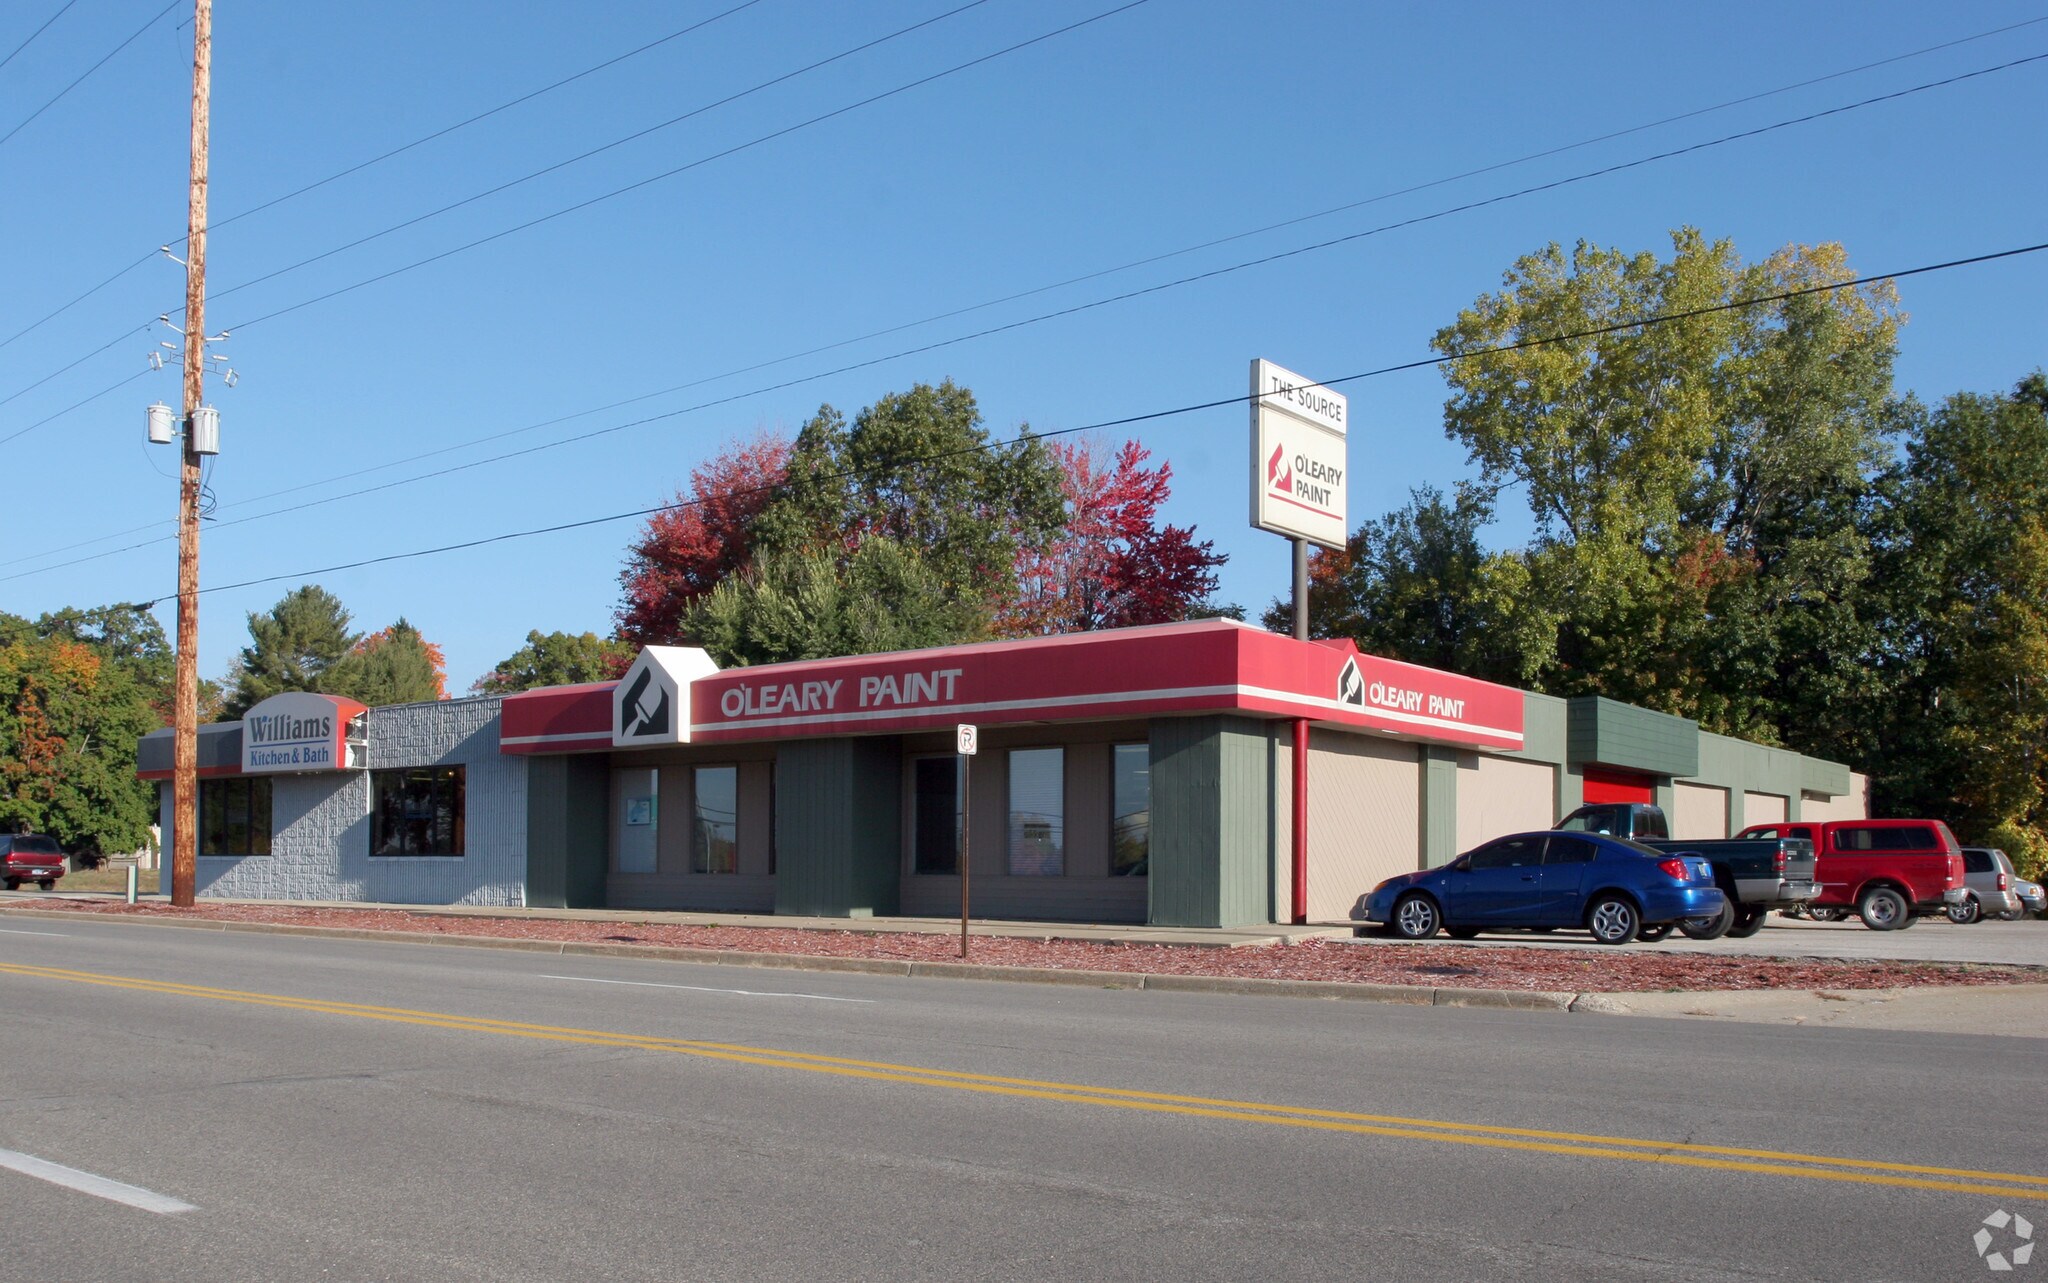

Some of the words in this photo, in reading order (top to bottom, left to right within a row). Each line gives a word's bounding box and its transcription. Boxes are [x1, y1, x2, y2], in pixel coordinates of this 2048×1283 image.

[1271, 376, 1293, 402] THE
[1298, 387, 1342, 422] SOURCE
[1295, 453, 1343, 487] O'LEARY
[1296, 479, 1331, 507] PAINT
[720, 679, 843, 718] O'LEARY
[859, 668, 963, 707] PAINT
[1369, 680, 1424, 712] O'LEARY
[1428, 694, 1465, 719] PAINT
[250, 714, 330, 743] Williams
[250, 750, 290, 767] Kitchen
[291, 747, 300, 764] &
[303, 747, 329, 763] Bath
